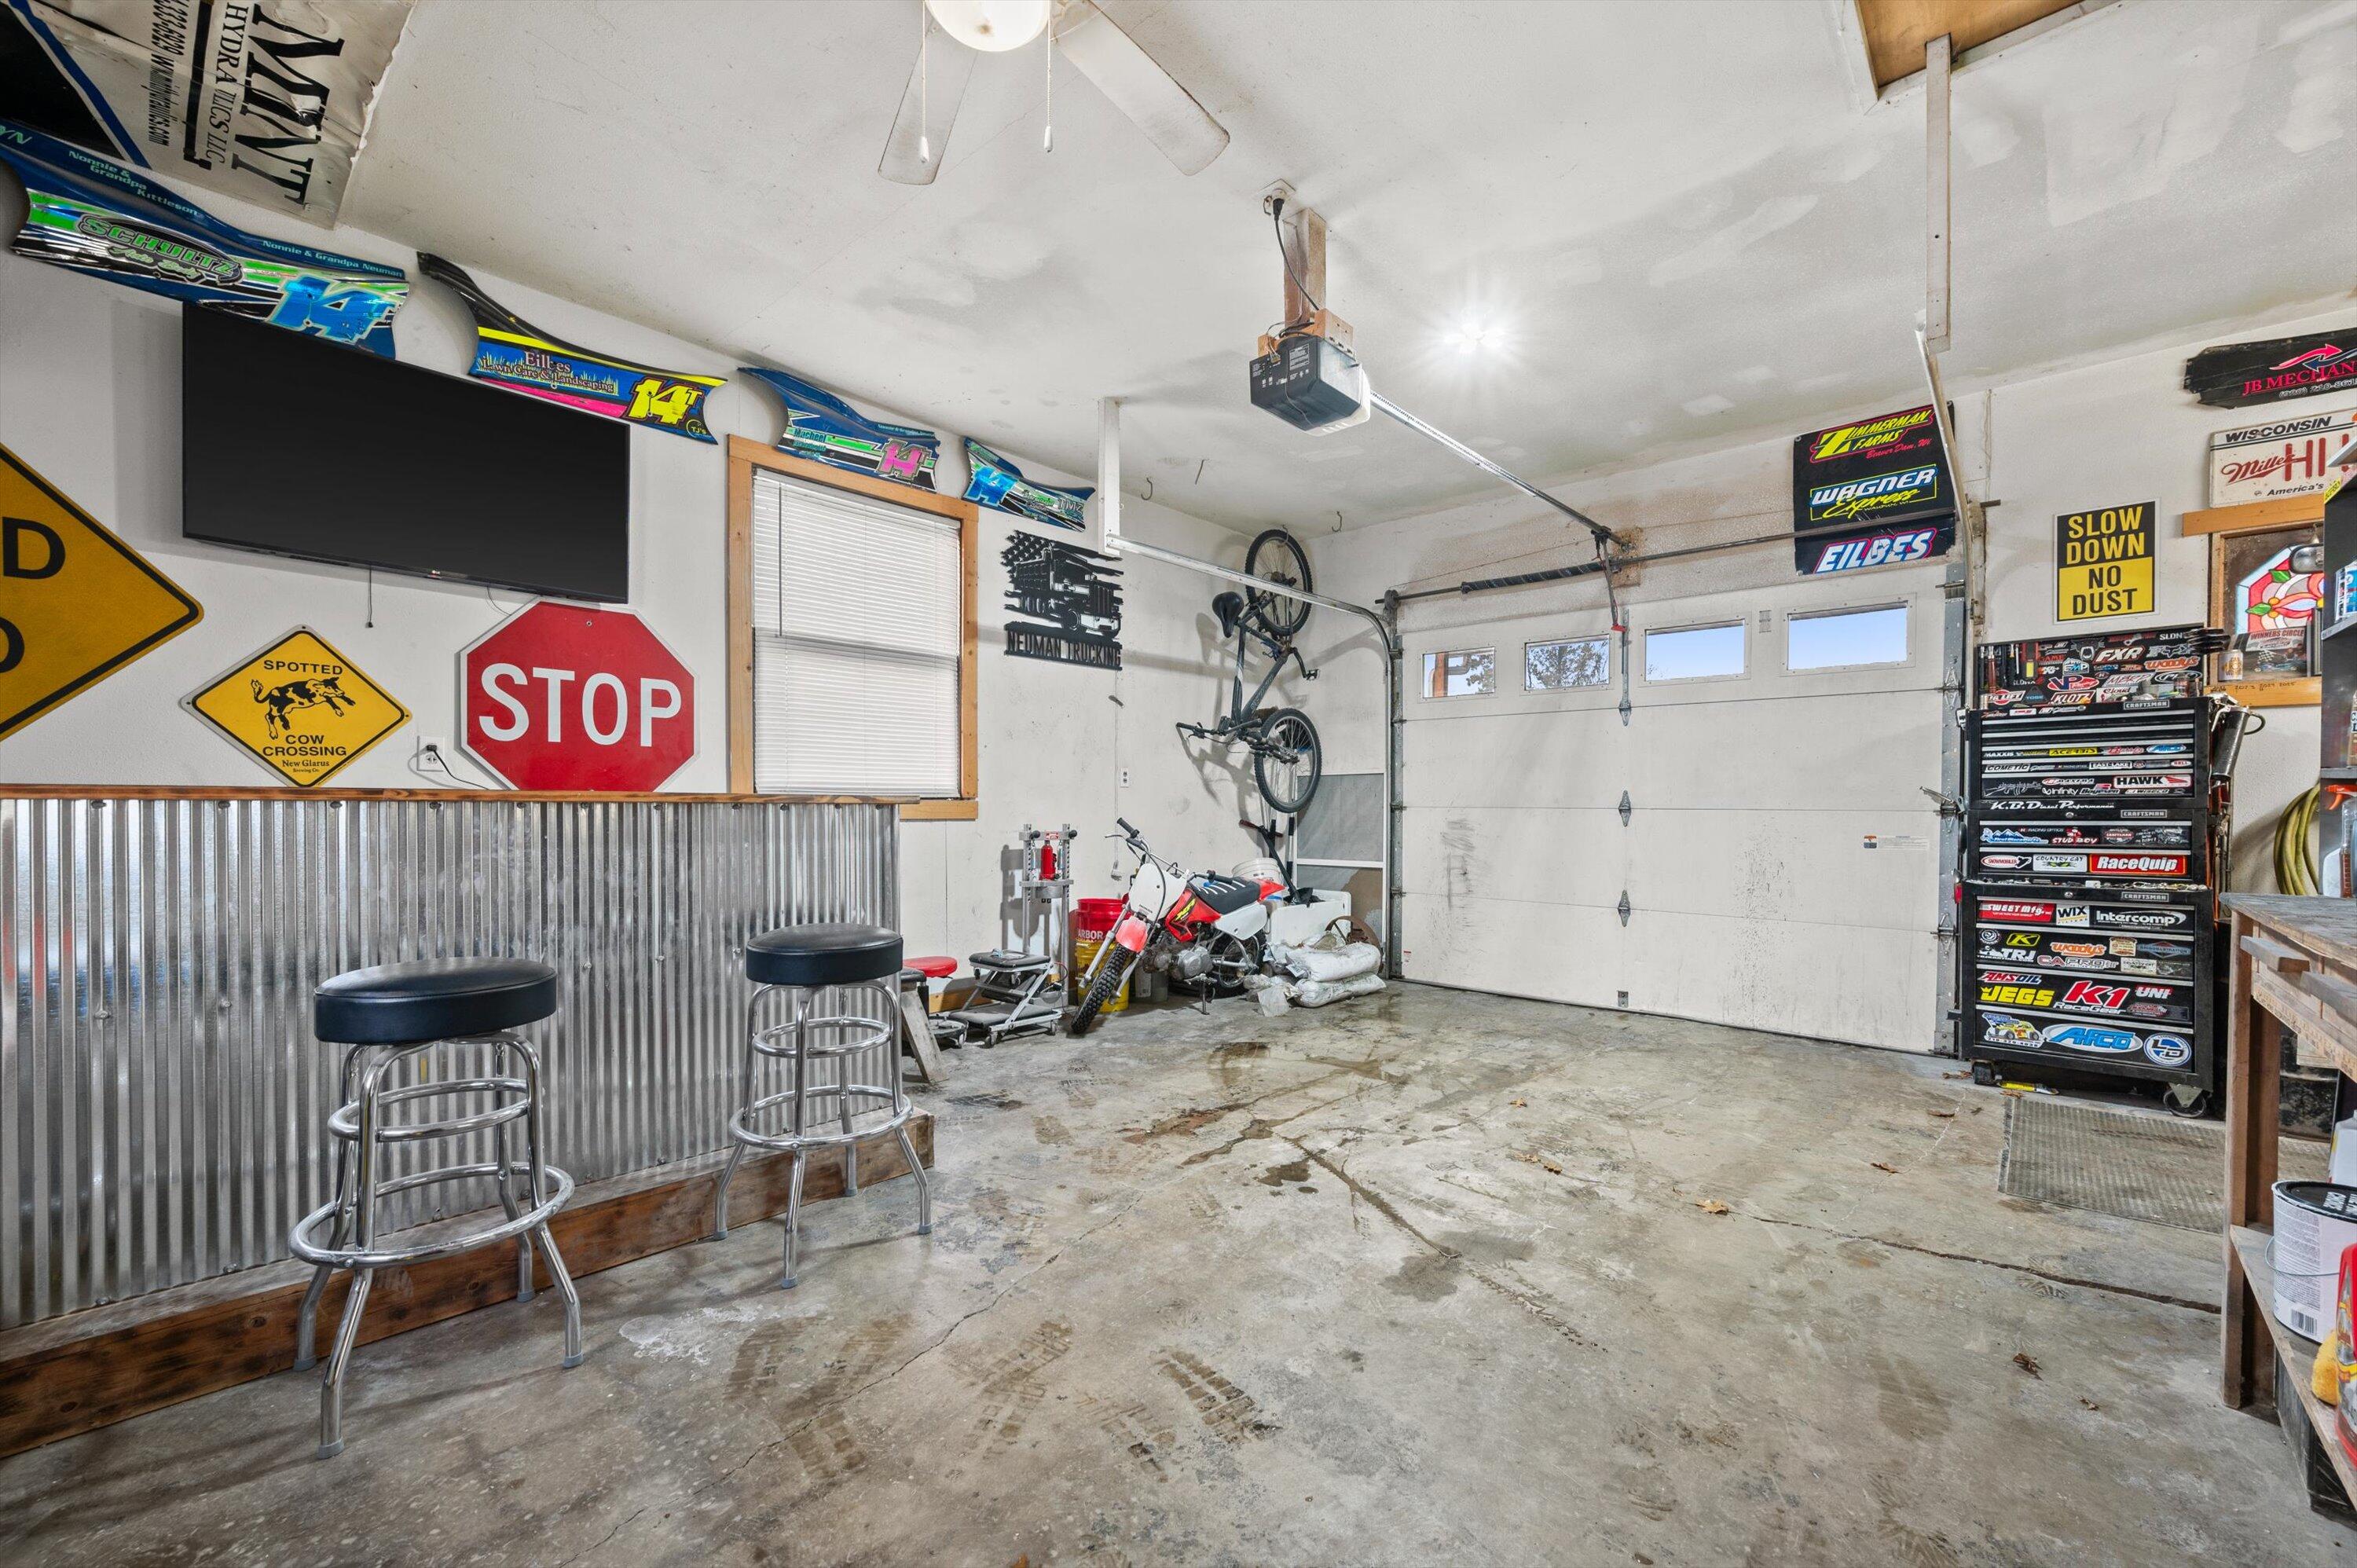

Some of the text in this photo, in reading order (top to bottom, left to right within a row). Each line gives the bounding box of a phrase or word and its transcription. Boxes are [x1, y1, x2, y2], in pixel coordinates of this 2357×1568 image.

[206, 132, 228, 164] LLC
[69, 150, 131, 178] Nonnie &
[90, 164, 147, 190] Grandpa
[82, 214, 236, 276] SCHULTZ
[262, 240, 403, 278] Nonnie & Grandpa Neuman
[269, 275, 398, 343] 14
[482, 355, 614, 393] Lawn Care & Landscaping
[2242, 361, 2357, 396] JB MECHAN
[1814, 409, 1933, 460] ZIMMERMAN
[1853, 429, 1904, 451] FARMS
[2225, 416, 2332, 443] WISCONSIN
[2220, 453, 2296, 485] Miller
[2267, 482, 2325, 496] America's
[1823, 489, 1920, 519] Express
[2068, 506, 2143, 539] SLOW
[1815, 531, 1934, 573] EILBES
[2066, 532, 2145, 565] DOWN
[2088, 565, 2121, 589] NO
[2073, 588, 2138, 616] DUST
[1007, 630, 1122, 667] NEUMAN TRUCKING
[2095, 647, 2144, 662] FXR
[263, 660, 343, 675] SPOTTED
[2049, 675, 2084, 690] VP
[478, 663, 682, 747] STOP
[262, 746, 347, 757] CROSSING
[285, 735, 324, 745] COW
[2097, 855, 2178, 871] RaceQuip
[1987, 903, 2021, 913] SWEET
[2058, 906, 2088, 918] WIX
[2096, 910, 2176, 926] Intercomp
[1982, 972, 2042, 984] AMSOIL
[1981, 985, 2055, 1006] JEGS
[2053, 1002, 2126, 1014] RaceGear
[2062, 980, 2130, 1009] K1
